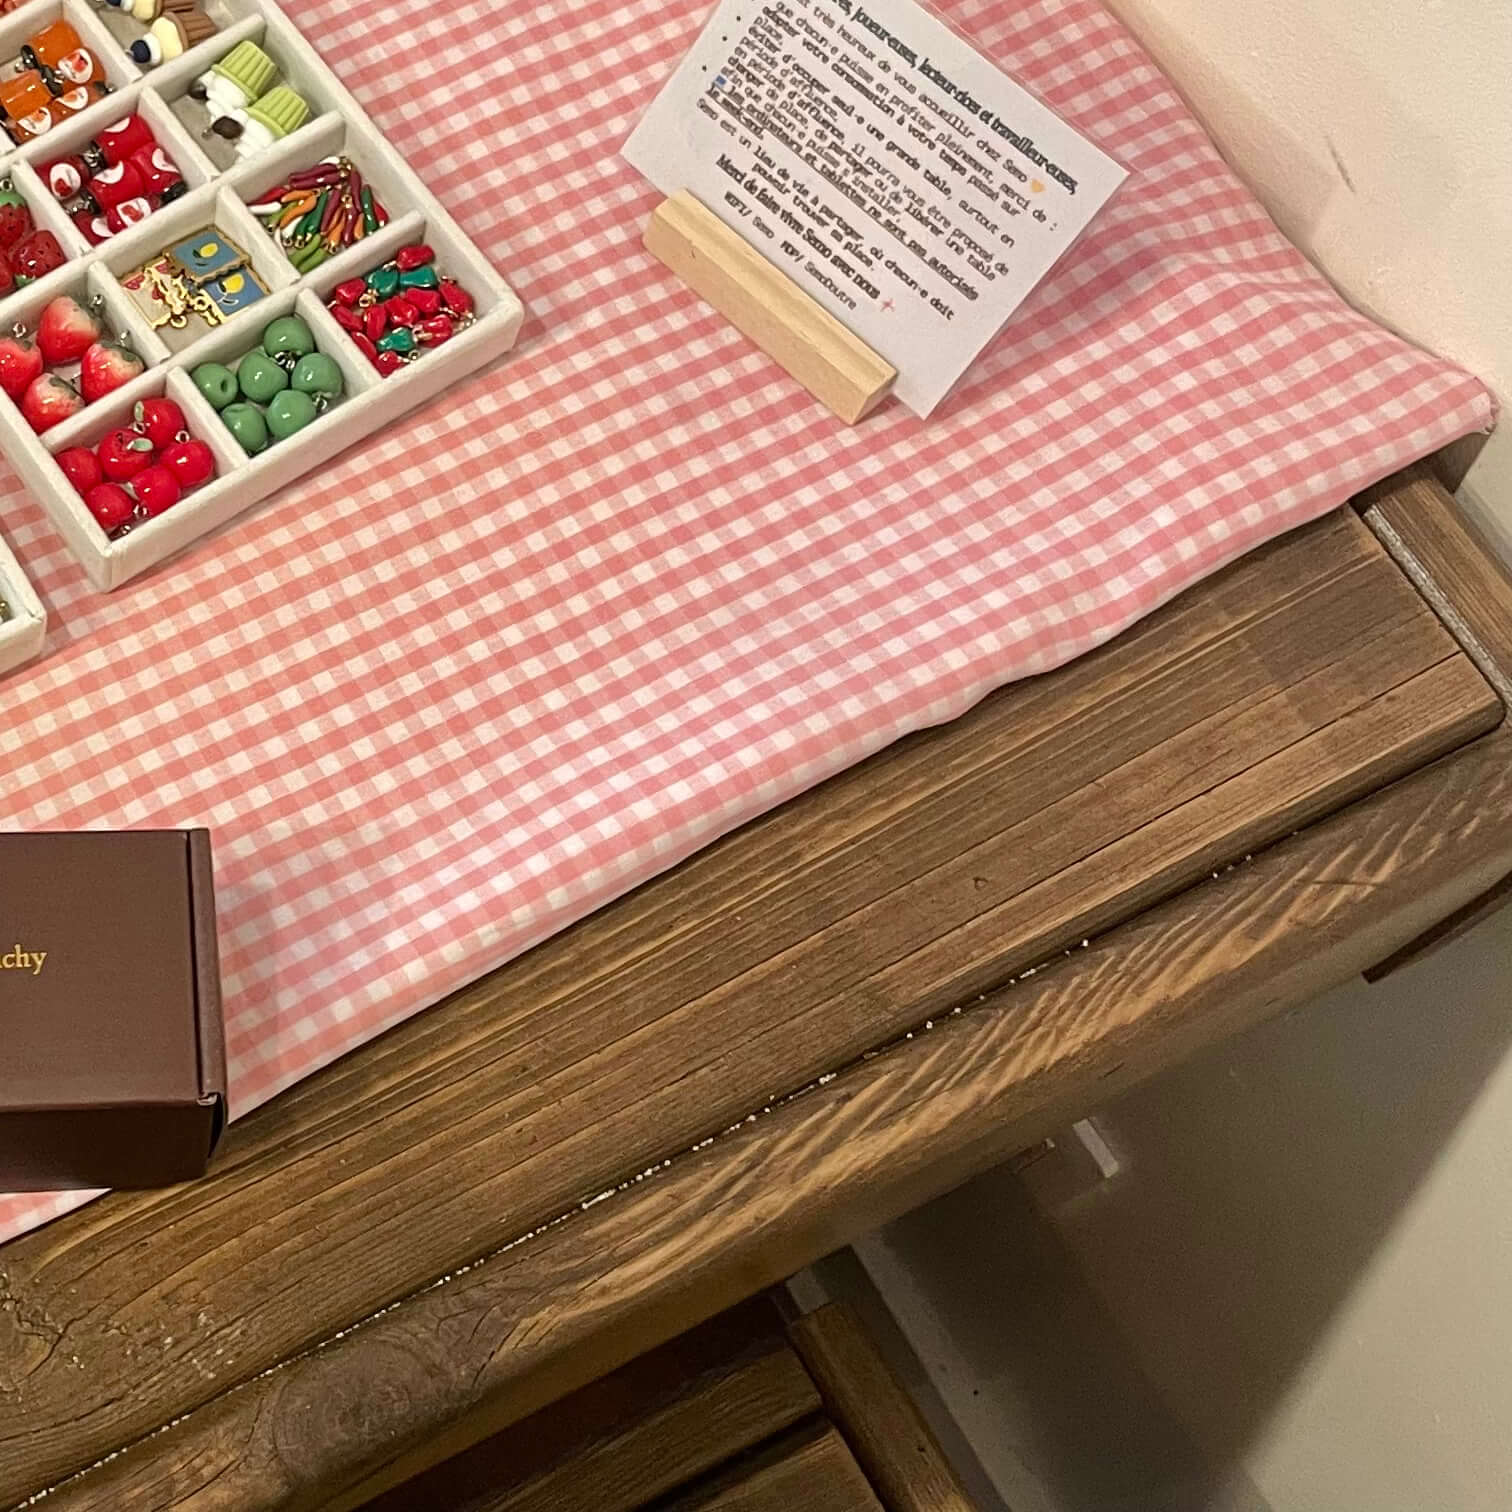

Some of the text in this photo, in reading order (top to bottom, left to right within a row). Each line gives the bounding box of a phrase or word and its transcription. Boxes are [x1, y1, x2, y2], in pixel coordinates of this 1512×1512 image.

[765, 87, 779, 101] de
[835, 23, 876, 61] heureux
[876, 59, 891, 73] de
[893, 71, 917, 95] vous
[917, 93, 975, 138] accueillir
[975, 139, 1002, 162] chez
[874, 82, 890, 96] en
[1031, 208, 1047, 223] de
[776, 167, 790, 181] de
[999, 233, 1015, 248] en
[993, 261, 1009, 276] de
